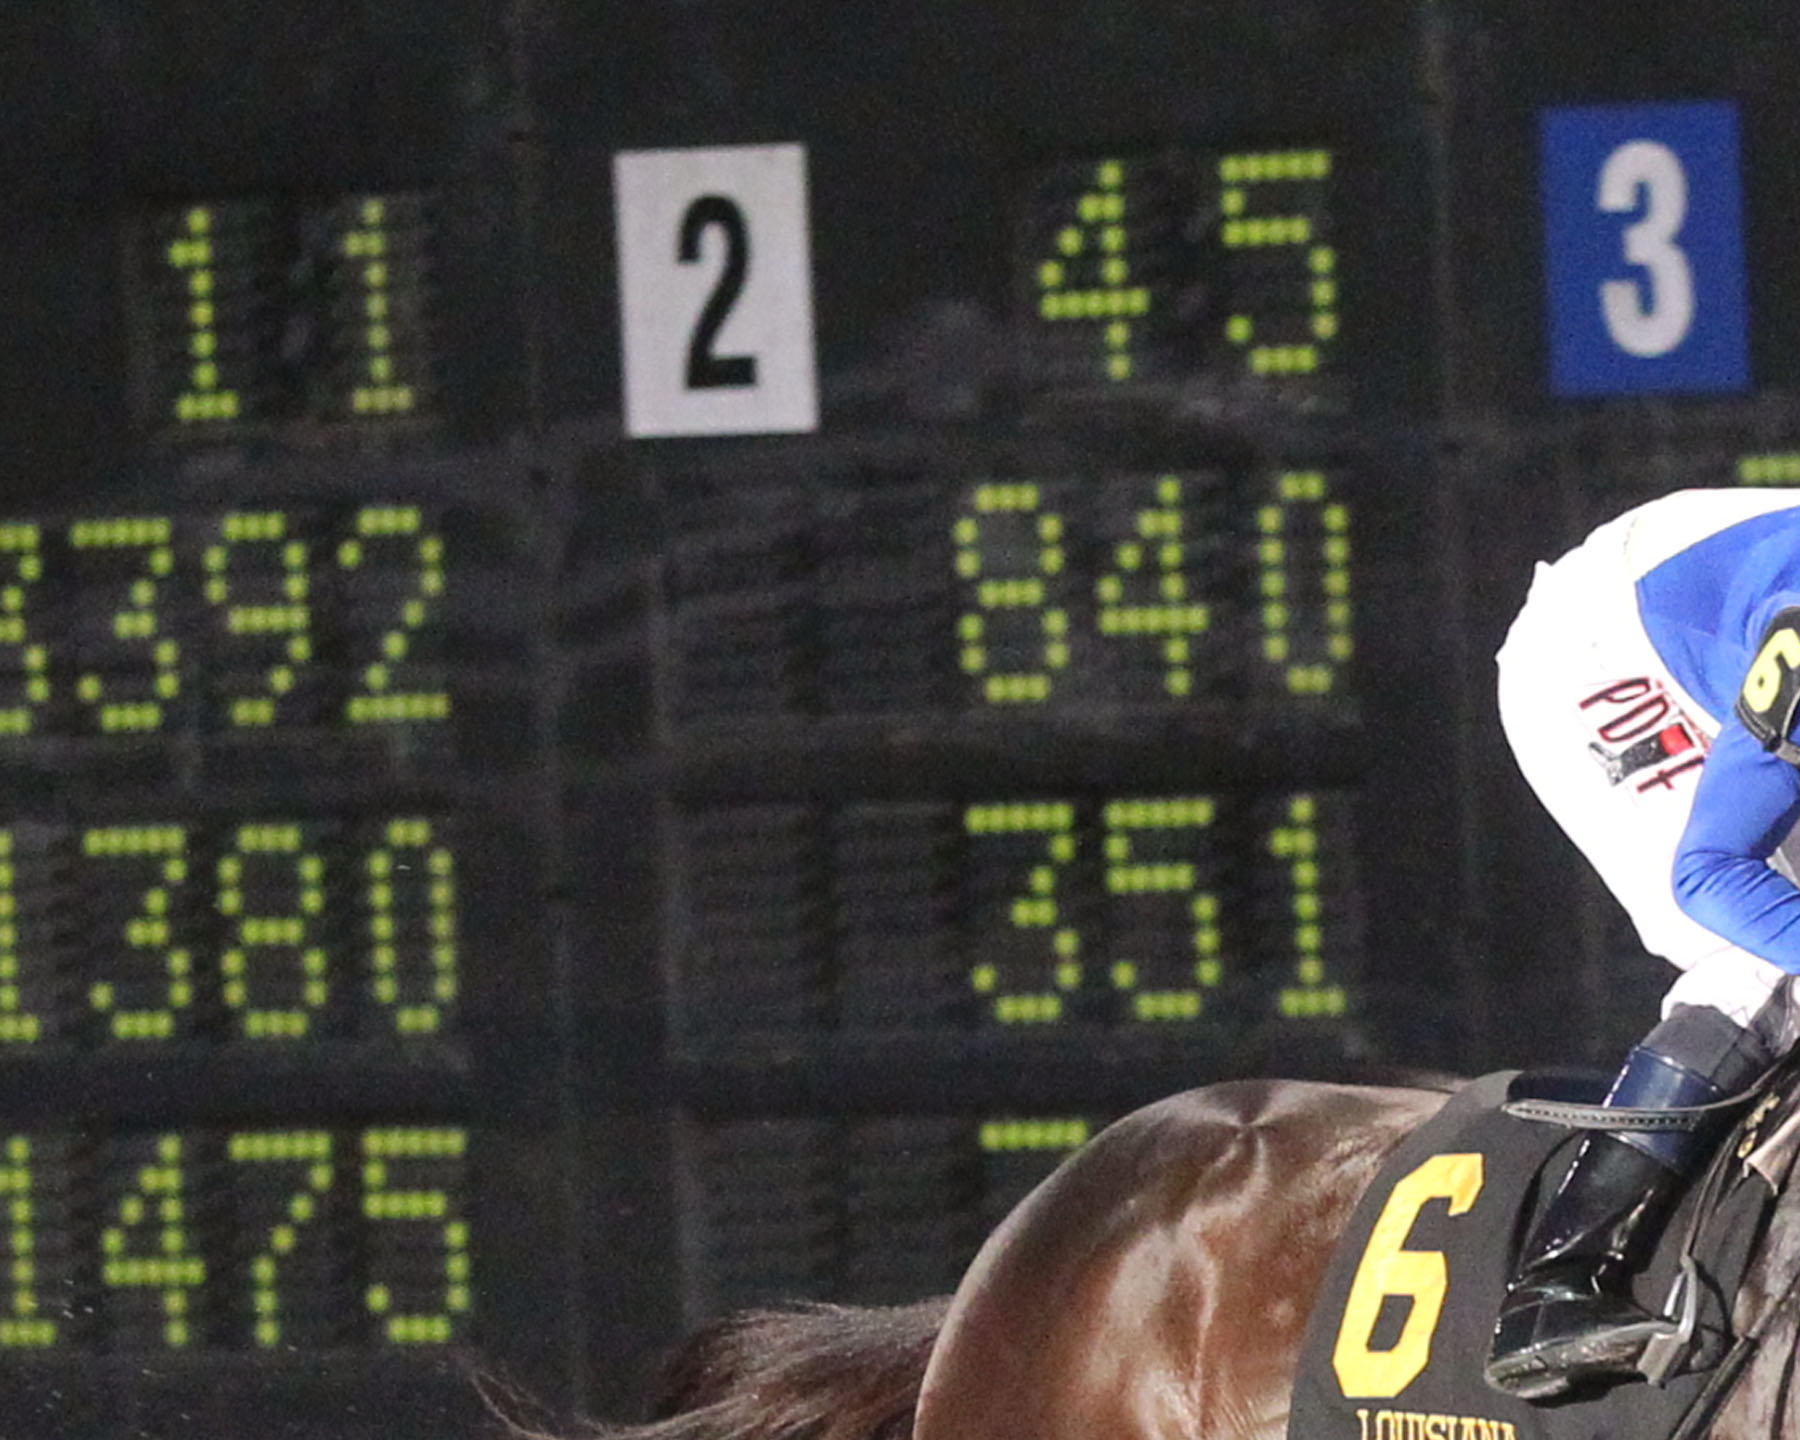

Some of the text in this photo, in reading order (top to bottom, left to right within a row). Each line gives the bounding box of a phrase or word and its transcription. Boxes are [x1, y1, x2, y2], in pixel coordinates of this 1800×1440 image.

[678, 194, 757, 391] 2
[1038, 150, 1338, 380] 45
[1598, 140, 1694, 358] 3
[954, 473, 1351, 703] 840
[964, 798, 1346, 1022] 351
[0, 1129, 470, 1347] 1475
[1332, 1153, 1484, 1399] 6
